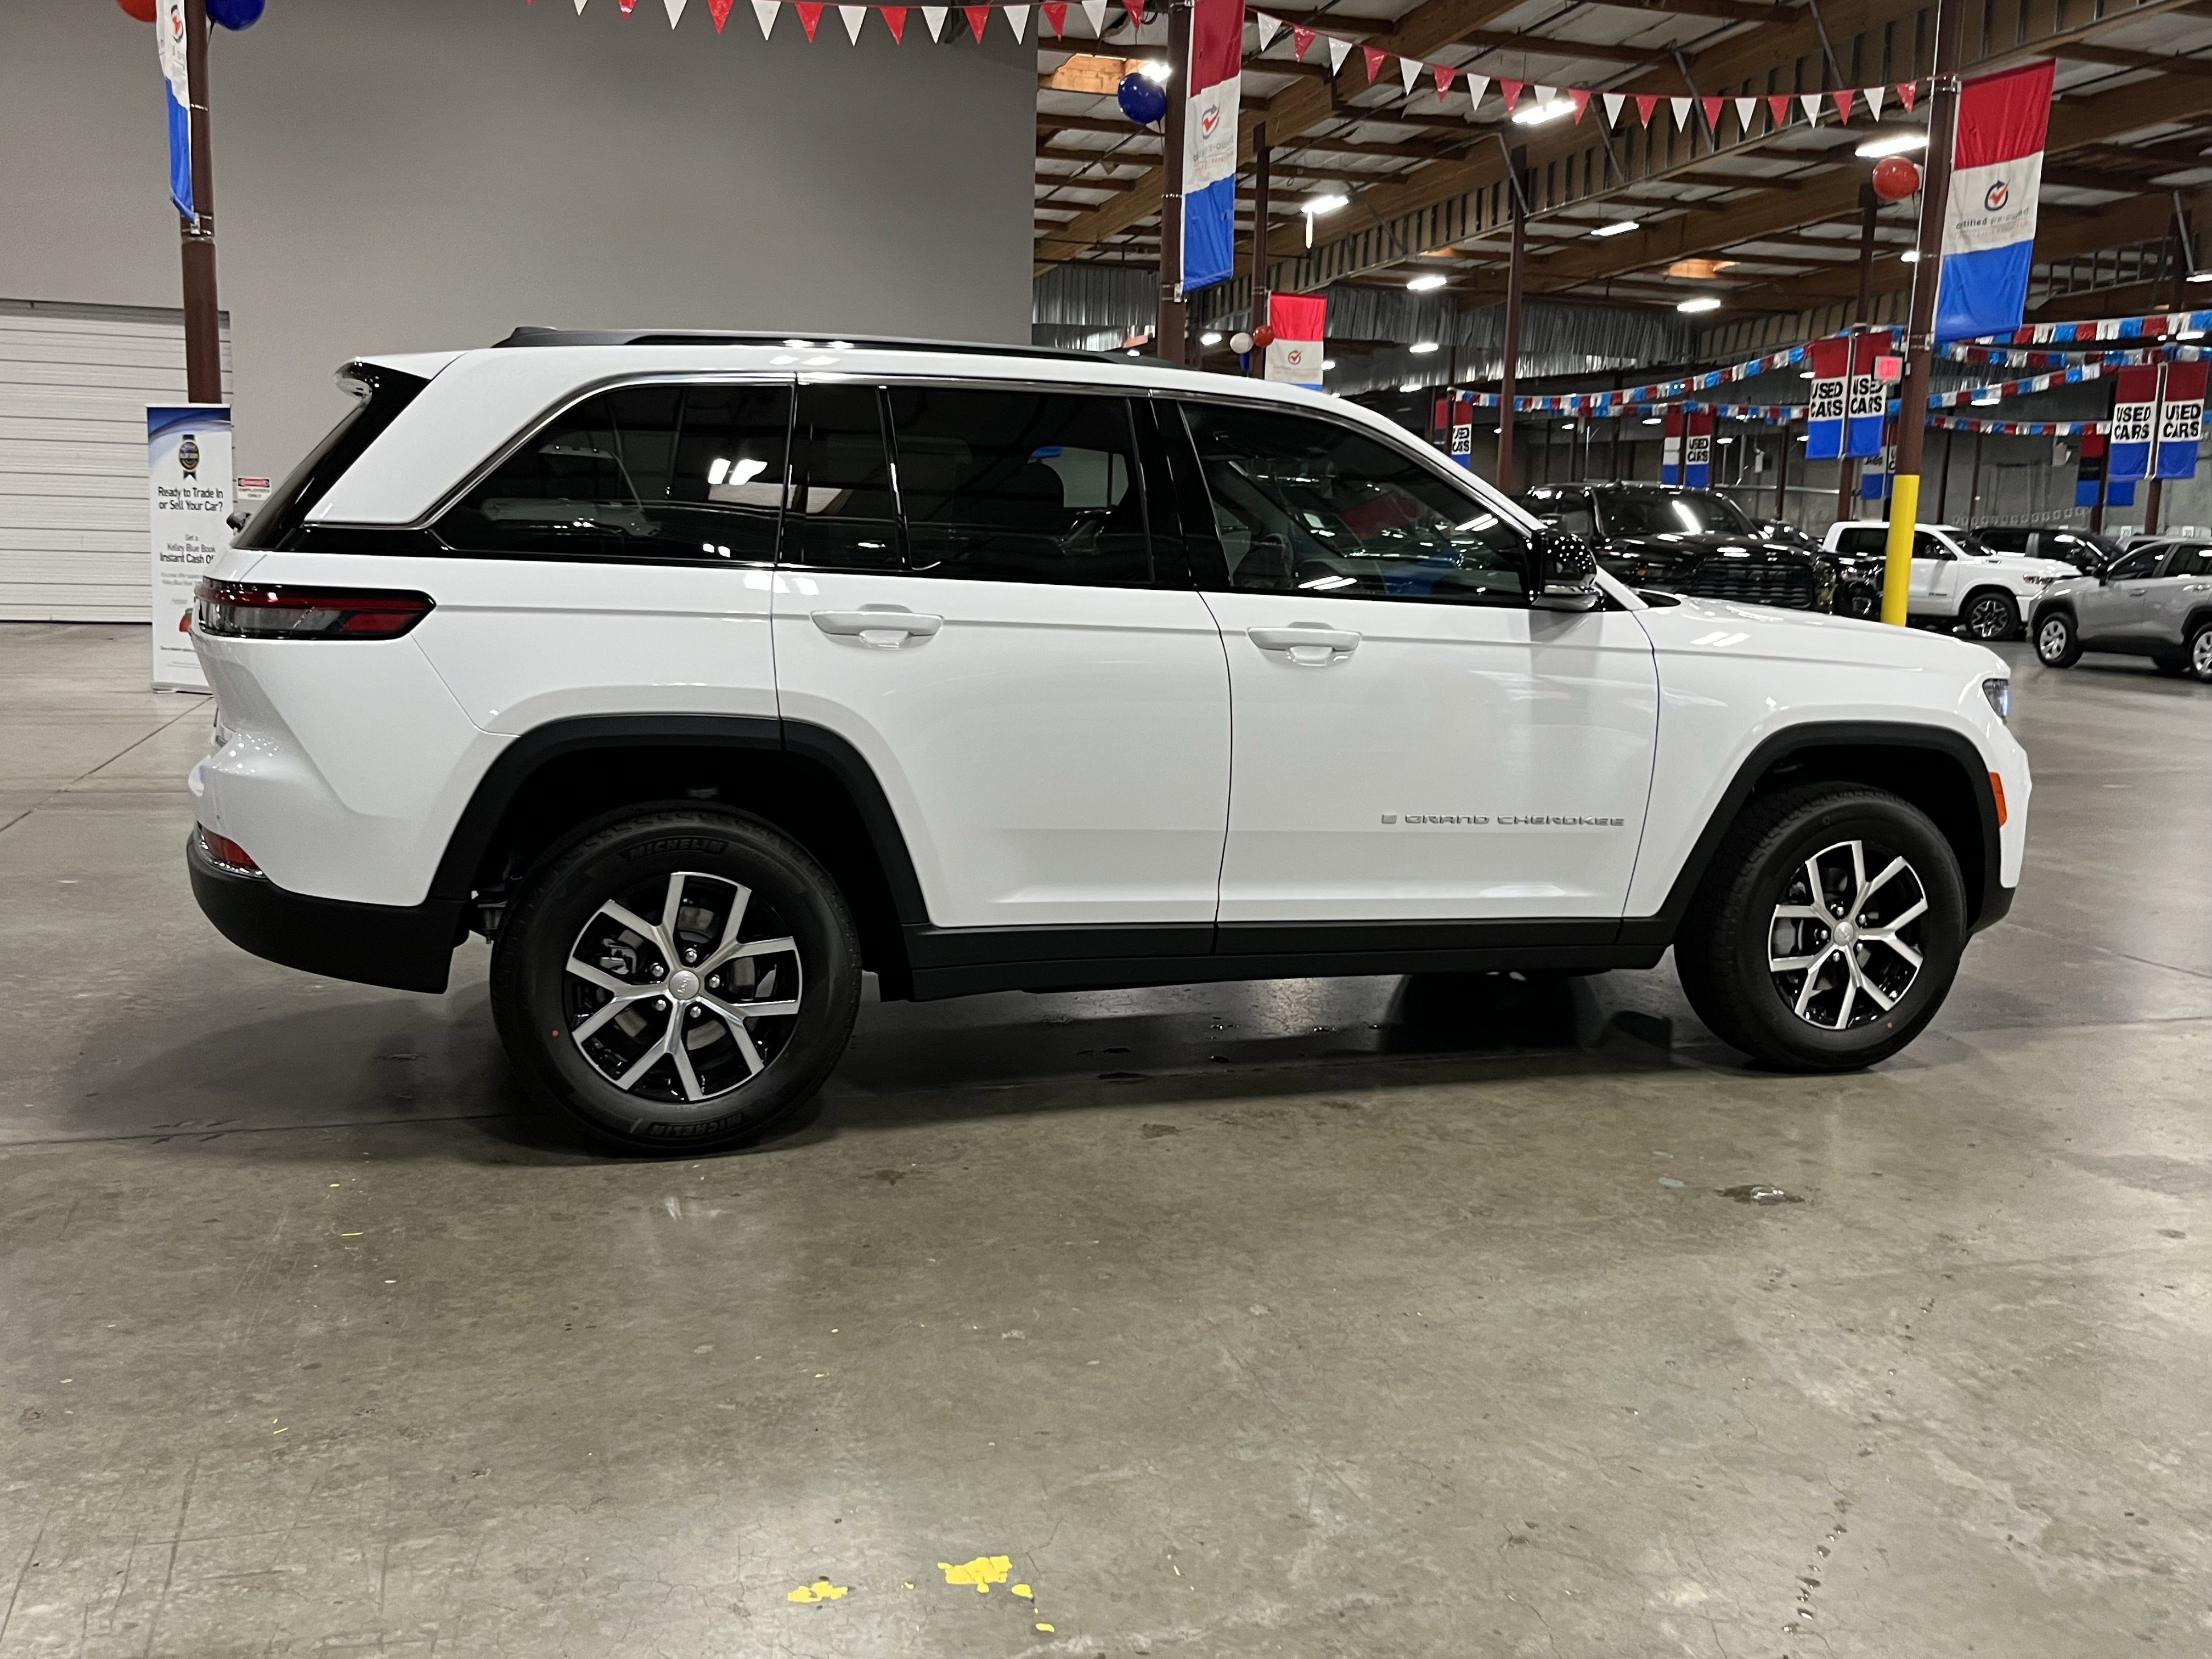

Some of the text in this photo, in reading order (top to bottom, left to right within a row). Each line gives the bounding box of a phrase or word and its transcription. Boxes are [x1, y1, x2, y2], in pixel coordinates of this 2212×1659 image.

[1812, 381, 1843, 399] USED
[1811, 399, 1843, 417] CARS
[1850, 396, 1882, 414] CARS
[2117, 407, 2151, 422] USED
[1453, 427, 1470, 439] UED
[2114, 424, 2149, 440] CARS
[2163, 421, 2200, 438] CARS
[158, 487, 224, 500] Ready to Trade In
[170, 500, 184, 510] Sell
[185, 500, 203, 510] Your
[205, 501, 223, 511] Car?
[186, 543, 200, 552] Blue
[201, 544, 216, 552] Book
[160, 552, 185, 562] Instant
[187, 554, 204, 563] Cash
[1404, 814, 1624, 826] GRAND CHEROKEE
[629, 839, 723, 859] MICHELIN
